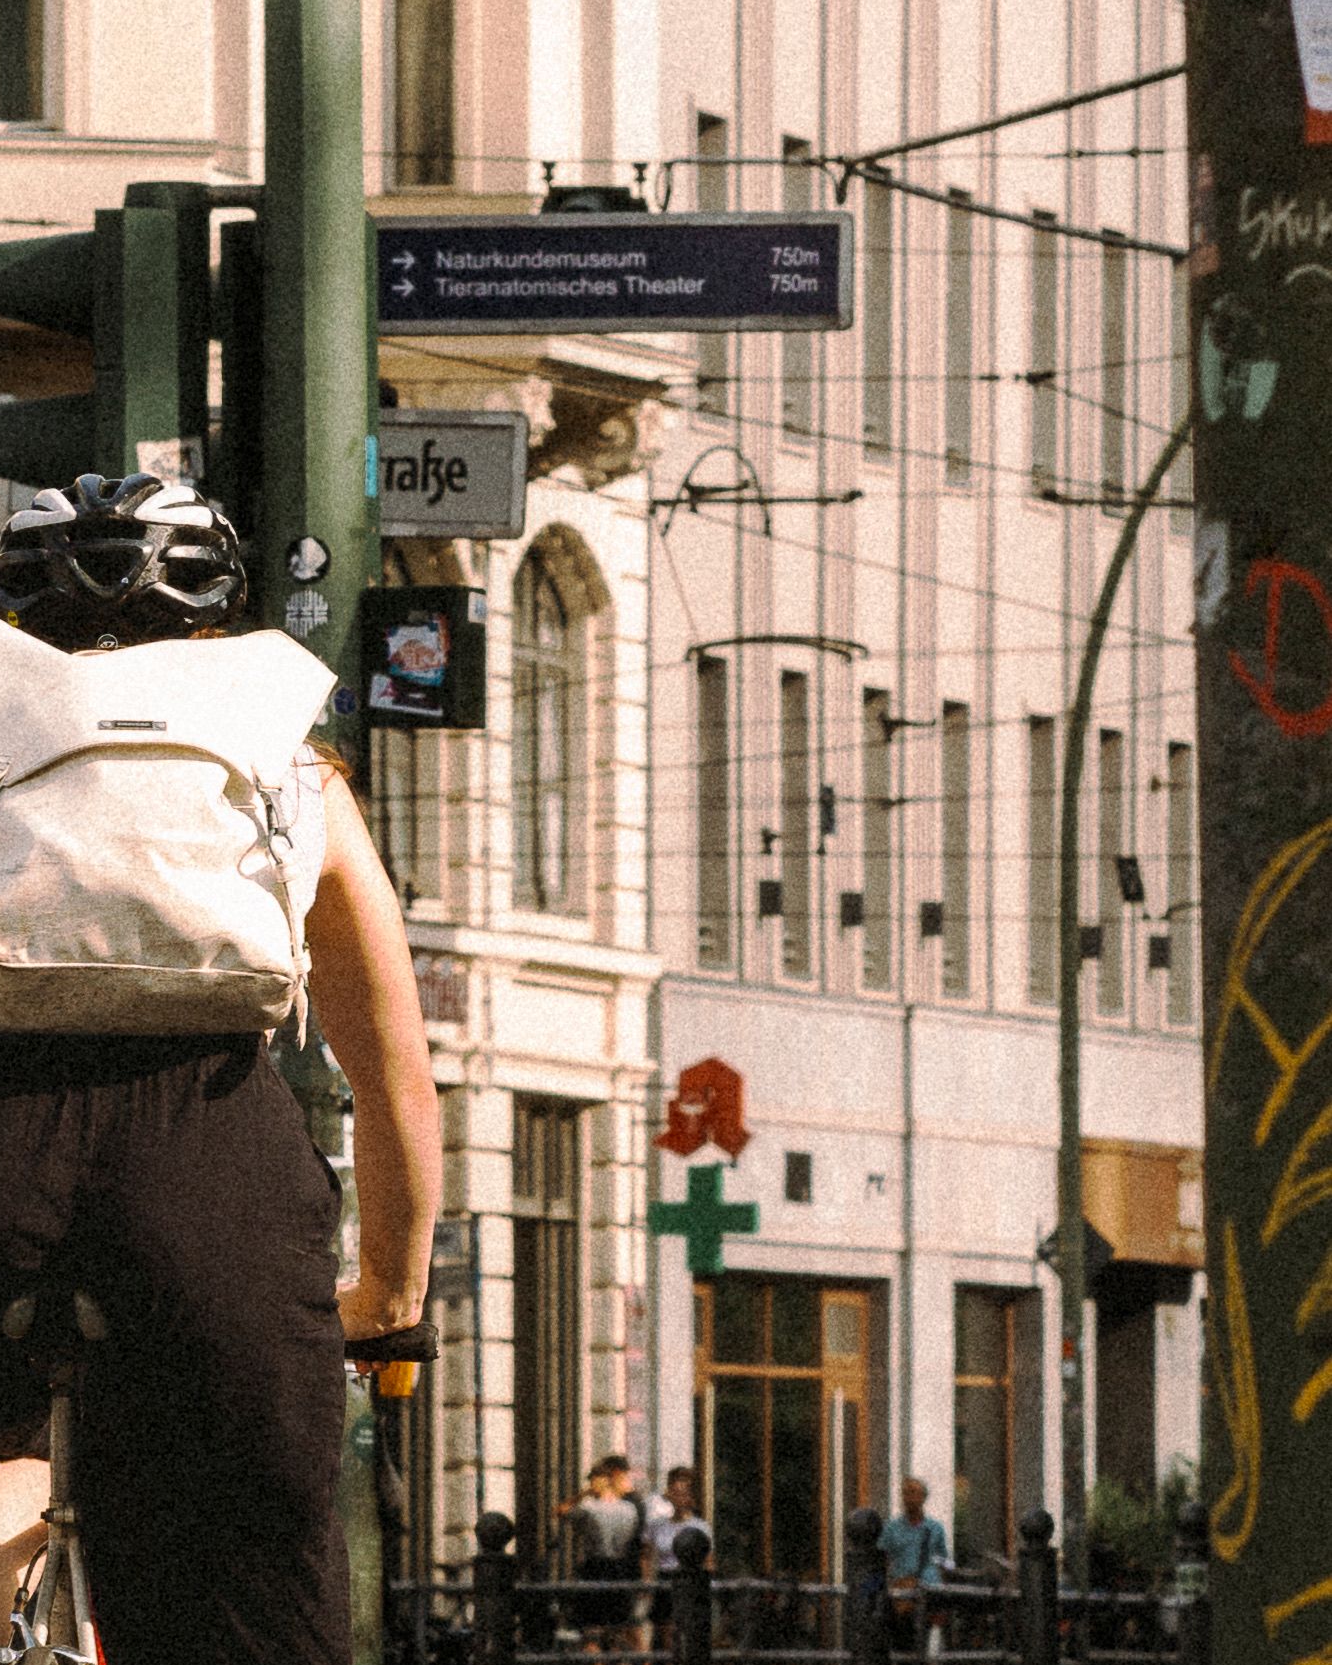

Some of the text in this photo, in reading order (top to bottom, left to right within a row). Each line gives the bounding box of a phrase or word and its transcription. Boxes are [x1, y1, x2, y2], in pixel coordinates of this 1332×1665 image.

[435, 246, 820, 270] Naturkundemuseum 750m
[435, 273, 818, 297] Tieranatomisches Theater 750m
[380, 438, 469, 506] raße
